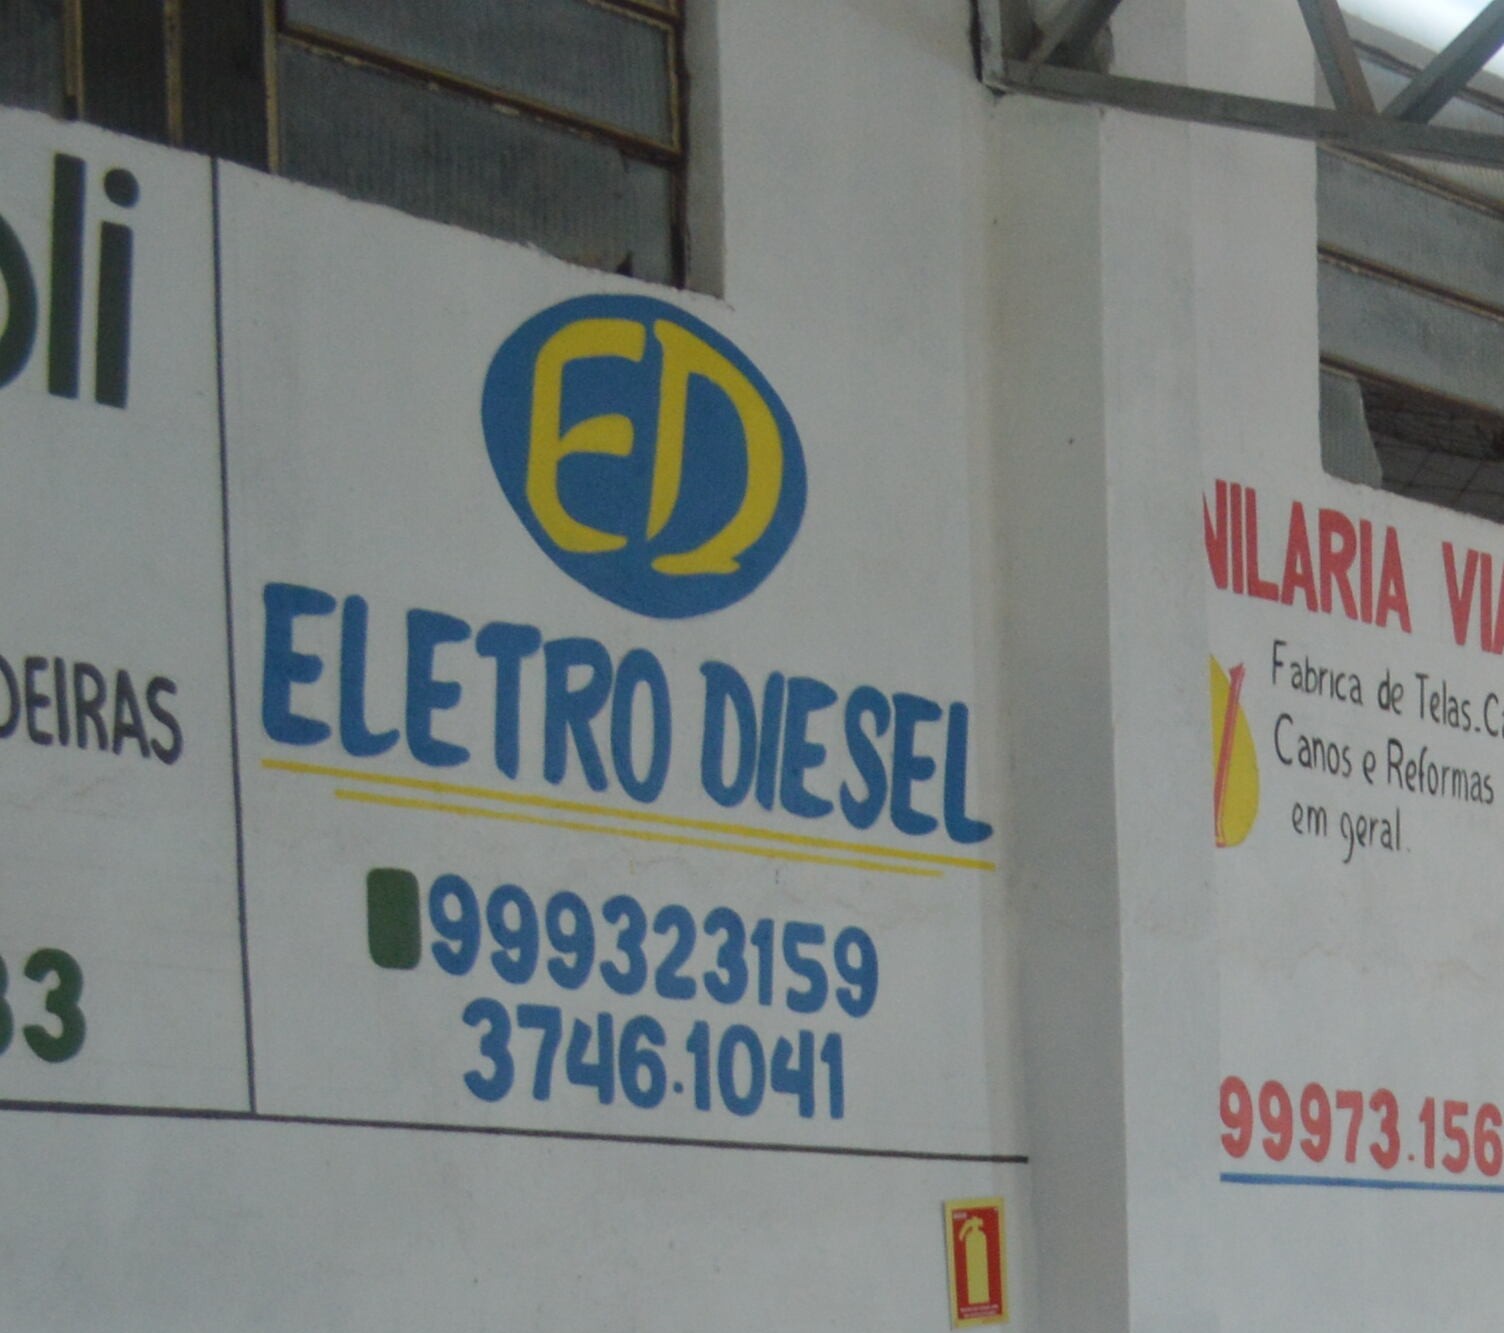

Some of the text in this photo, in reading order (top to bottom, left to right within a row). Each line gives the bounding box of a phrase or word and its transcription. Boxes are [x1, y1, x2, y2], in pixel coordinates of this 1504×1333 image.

[526, 318, 783, 576] ED
[261, 582, 994, 844] ELETRO DIESEL
[1272, 639, 1363, 706] Fabrica
[1377, 668, 1404, 715] de
[1273, 712, 1352, 778] Canos
[1362, 750, 1377, 785] e
[1387, 737, 1495, 805] Reformas
[1292, 801, 1328, 837] em
[0, 946, 88, 1063] 3
[428, 873, 880, 1018] 999323159
[462, 997, 845, 1120] 3746.1041
